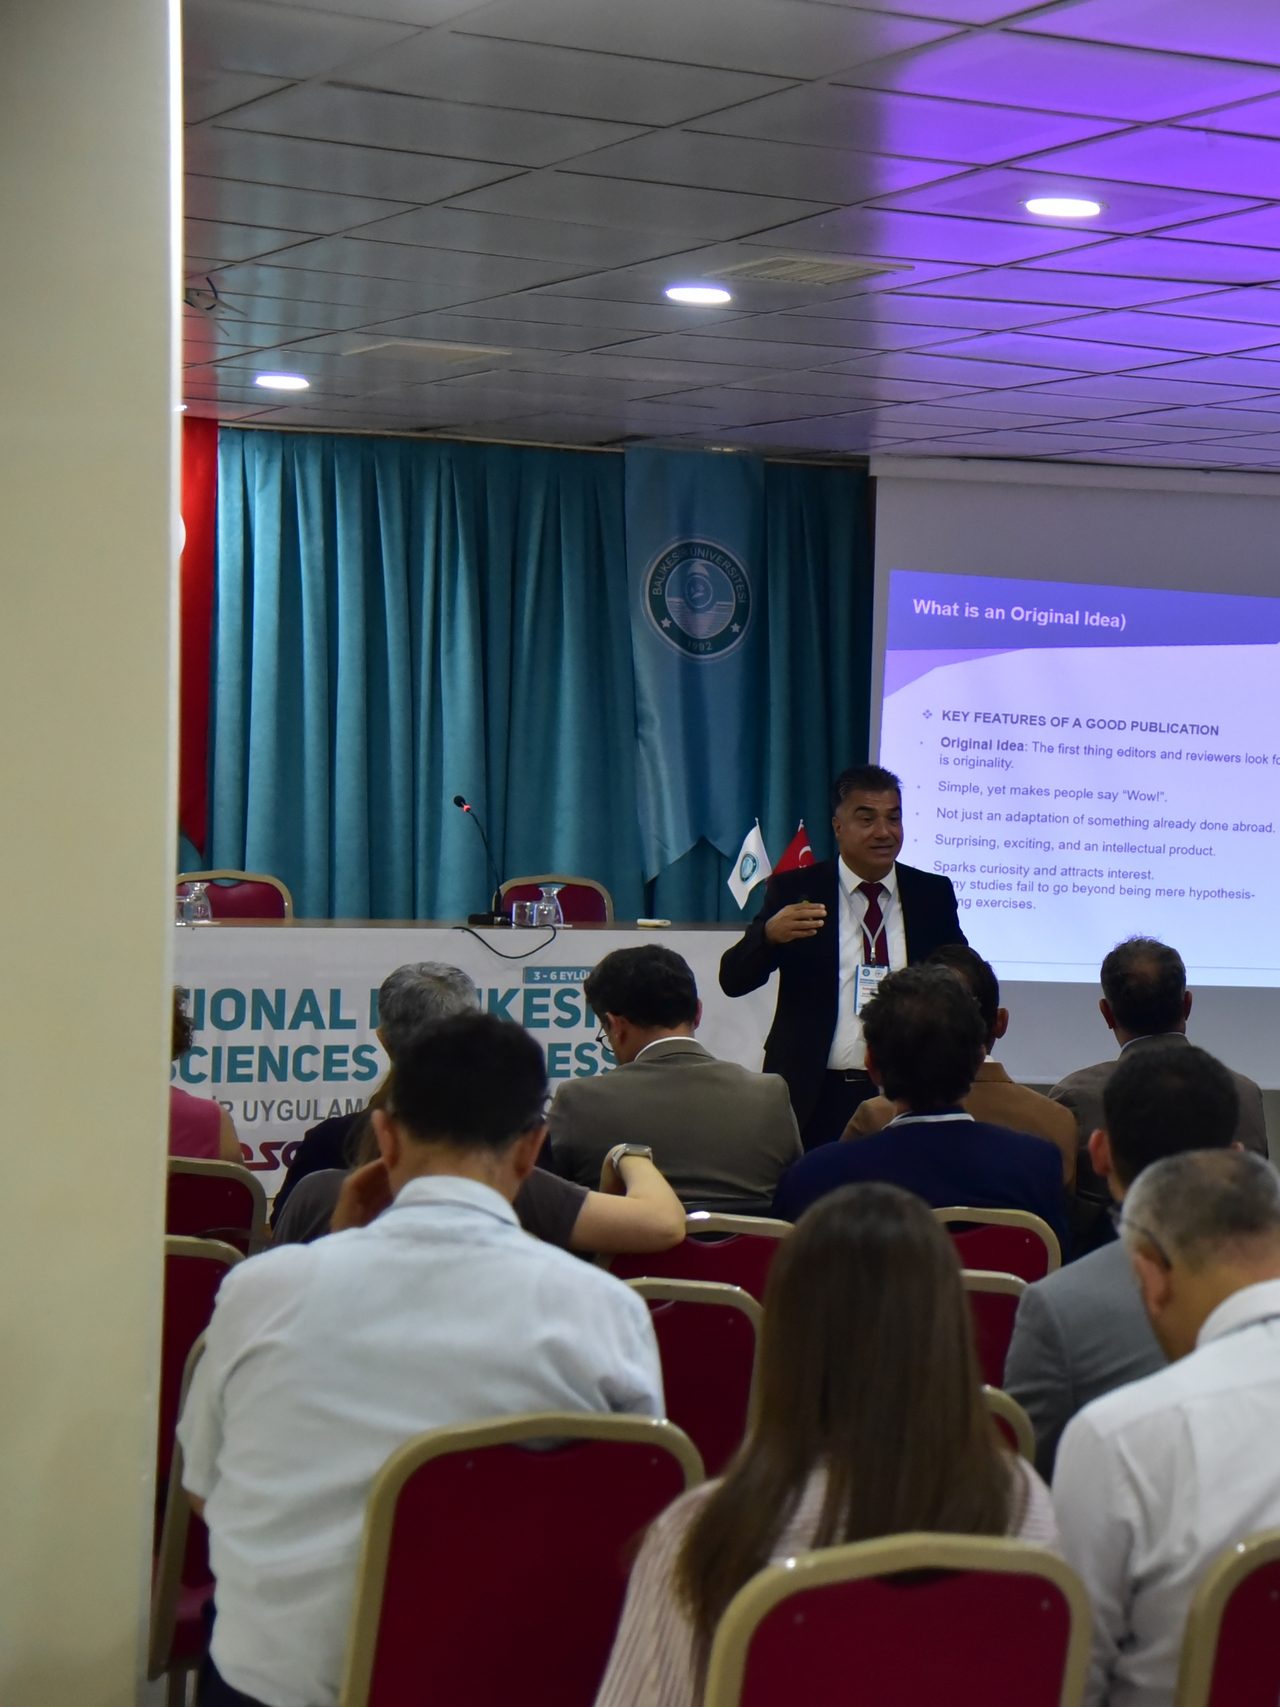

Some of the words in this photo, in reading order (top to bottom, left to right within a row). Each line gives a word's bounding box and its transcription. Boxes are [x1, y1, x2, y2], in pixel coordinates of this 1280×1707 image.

[913, 599, 959, 616] What
[965, 602, 979, 618] is
[985, 607, 1005, 620] an
[1010, 606, 1079, 626] Original
[1084, 611, 1126, 631] Idea)
[942, 710, 970, 722] KEY
[974, 712, 1046, 726] FEATURES
[1050, 717, 1069, 728] OF
[1072, 718, 1082, 728] A
[1086, 718, 1127, 731] GOOD
[1131, 720, 1220, 736] PUBLICATION
[939, 754, 950, 765] is
[953, 755, 1014, 771] originality.
[940, 737, 993, 752] Original
[997, 740, 1029, 752] Idea:
[1032, 741, 1055, 754] The
[1058, 743, 1080, 755] first
[1083, 744, 1113, 759] thing
[1117, 747, 1157, 759] editors
[1160, 749, 1183, 760] and
[1186, 750, 1242, 764] reviewers
[1245, 753, 1269, 765] look
[938, 781, 983, 796] Simple,
[987, 785, 1006, 797] yet
[1010, 785, 1050, 797] makes
[1054, 788, 1094, 801] people
[1097, 791, 1119, 802] say
[936, 807, 958, 819] Not
[961, 809, 983, 822] just
[987, 812, 1002, 821] an
[1005, 811, 1069, 825] adaptation
[1073, 814, 1084, 825] of
[1087, 816, 1150, 830] something
[1153, 817, 1196, 832] already
[1200, 819, 1229, 831] done
[1232, 821, 1276, 833] abroad.
[935, 834, 999, 849] Surprising,
[1003, 838, 1055, 852] exciting,
[1058, 840, 1081, 850] and
[1084, 843, 1098, 852] an
[1102, 841, 1166, 854] intellectual
[1169, 845, 1216, 857] product.
[933, 861, 976, 874] Sparks
[980, 863, 1030, 878] curiosity
[1033, 865, 1057, 876] and
[1060, 867, 1104, 878] attracts
[1107, 867, 1154, 880] interest.
[951, 880, 966, 891] ny
[970, 880, 1013, 891] studies
[1017, 881, 1034, 892] fail
[1038, 882, 1049, 893] to
[1053, 884, 1068, 895] go
[1072, 883, 1116, 896] beyond
[1119, 885, 1151, 898] being
[1155, 888, 1186, 898] mere
[1189, 887, 1255, 900] hypothesis-
[976, 898, 1036, 910] exercises.
[533, 971, 541, 980] 3
[550, 971, 557, 980] 6
[181, 988, 356, 1031] IONAL
[170, 1044, 378, 1084] CIENCES
